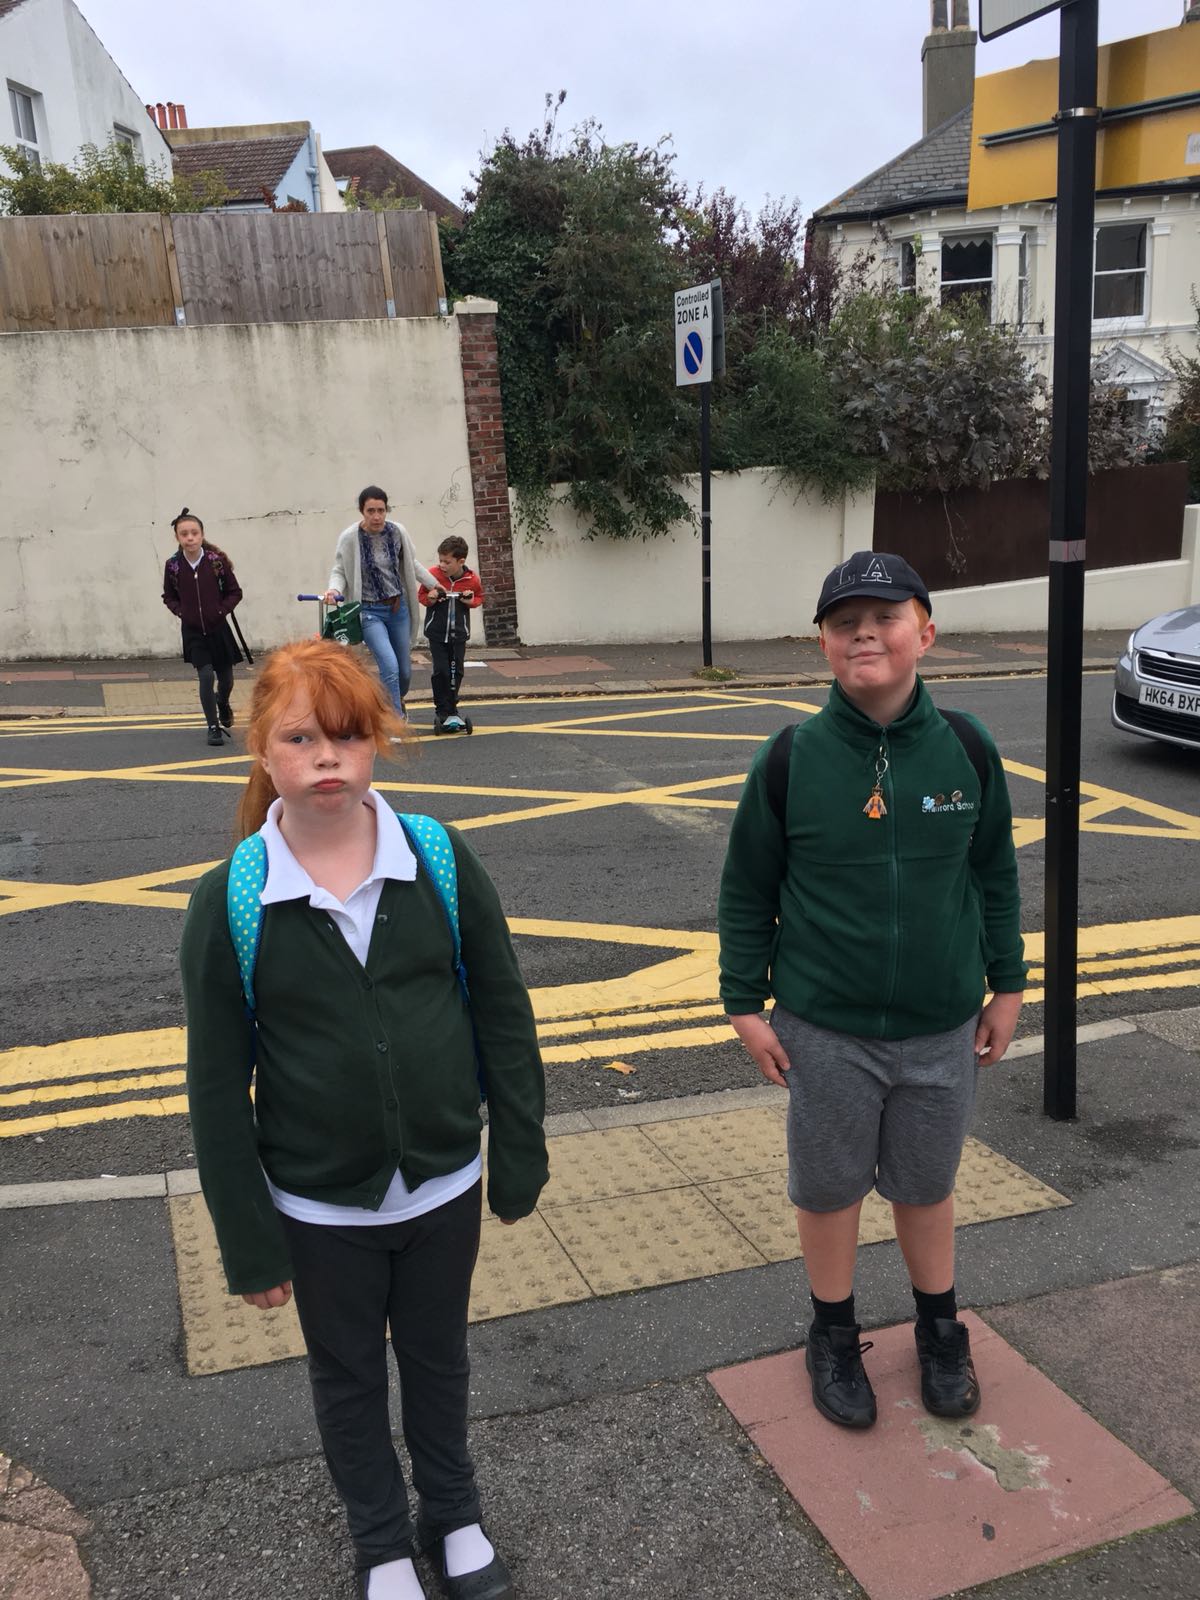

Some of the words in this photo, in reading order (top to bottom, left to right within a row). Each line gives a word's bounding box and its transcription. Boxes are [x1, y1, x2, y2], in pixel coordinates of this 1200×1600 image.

[676, 288, 709, 308] Controlled
[677, 307, 700, 325] ZONE
[702, 304, 709, 320] A
[1144, 687, 1175, 708] HK64
